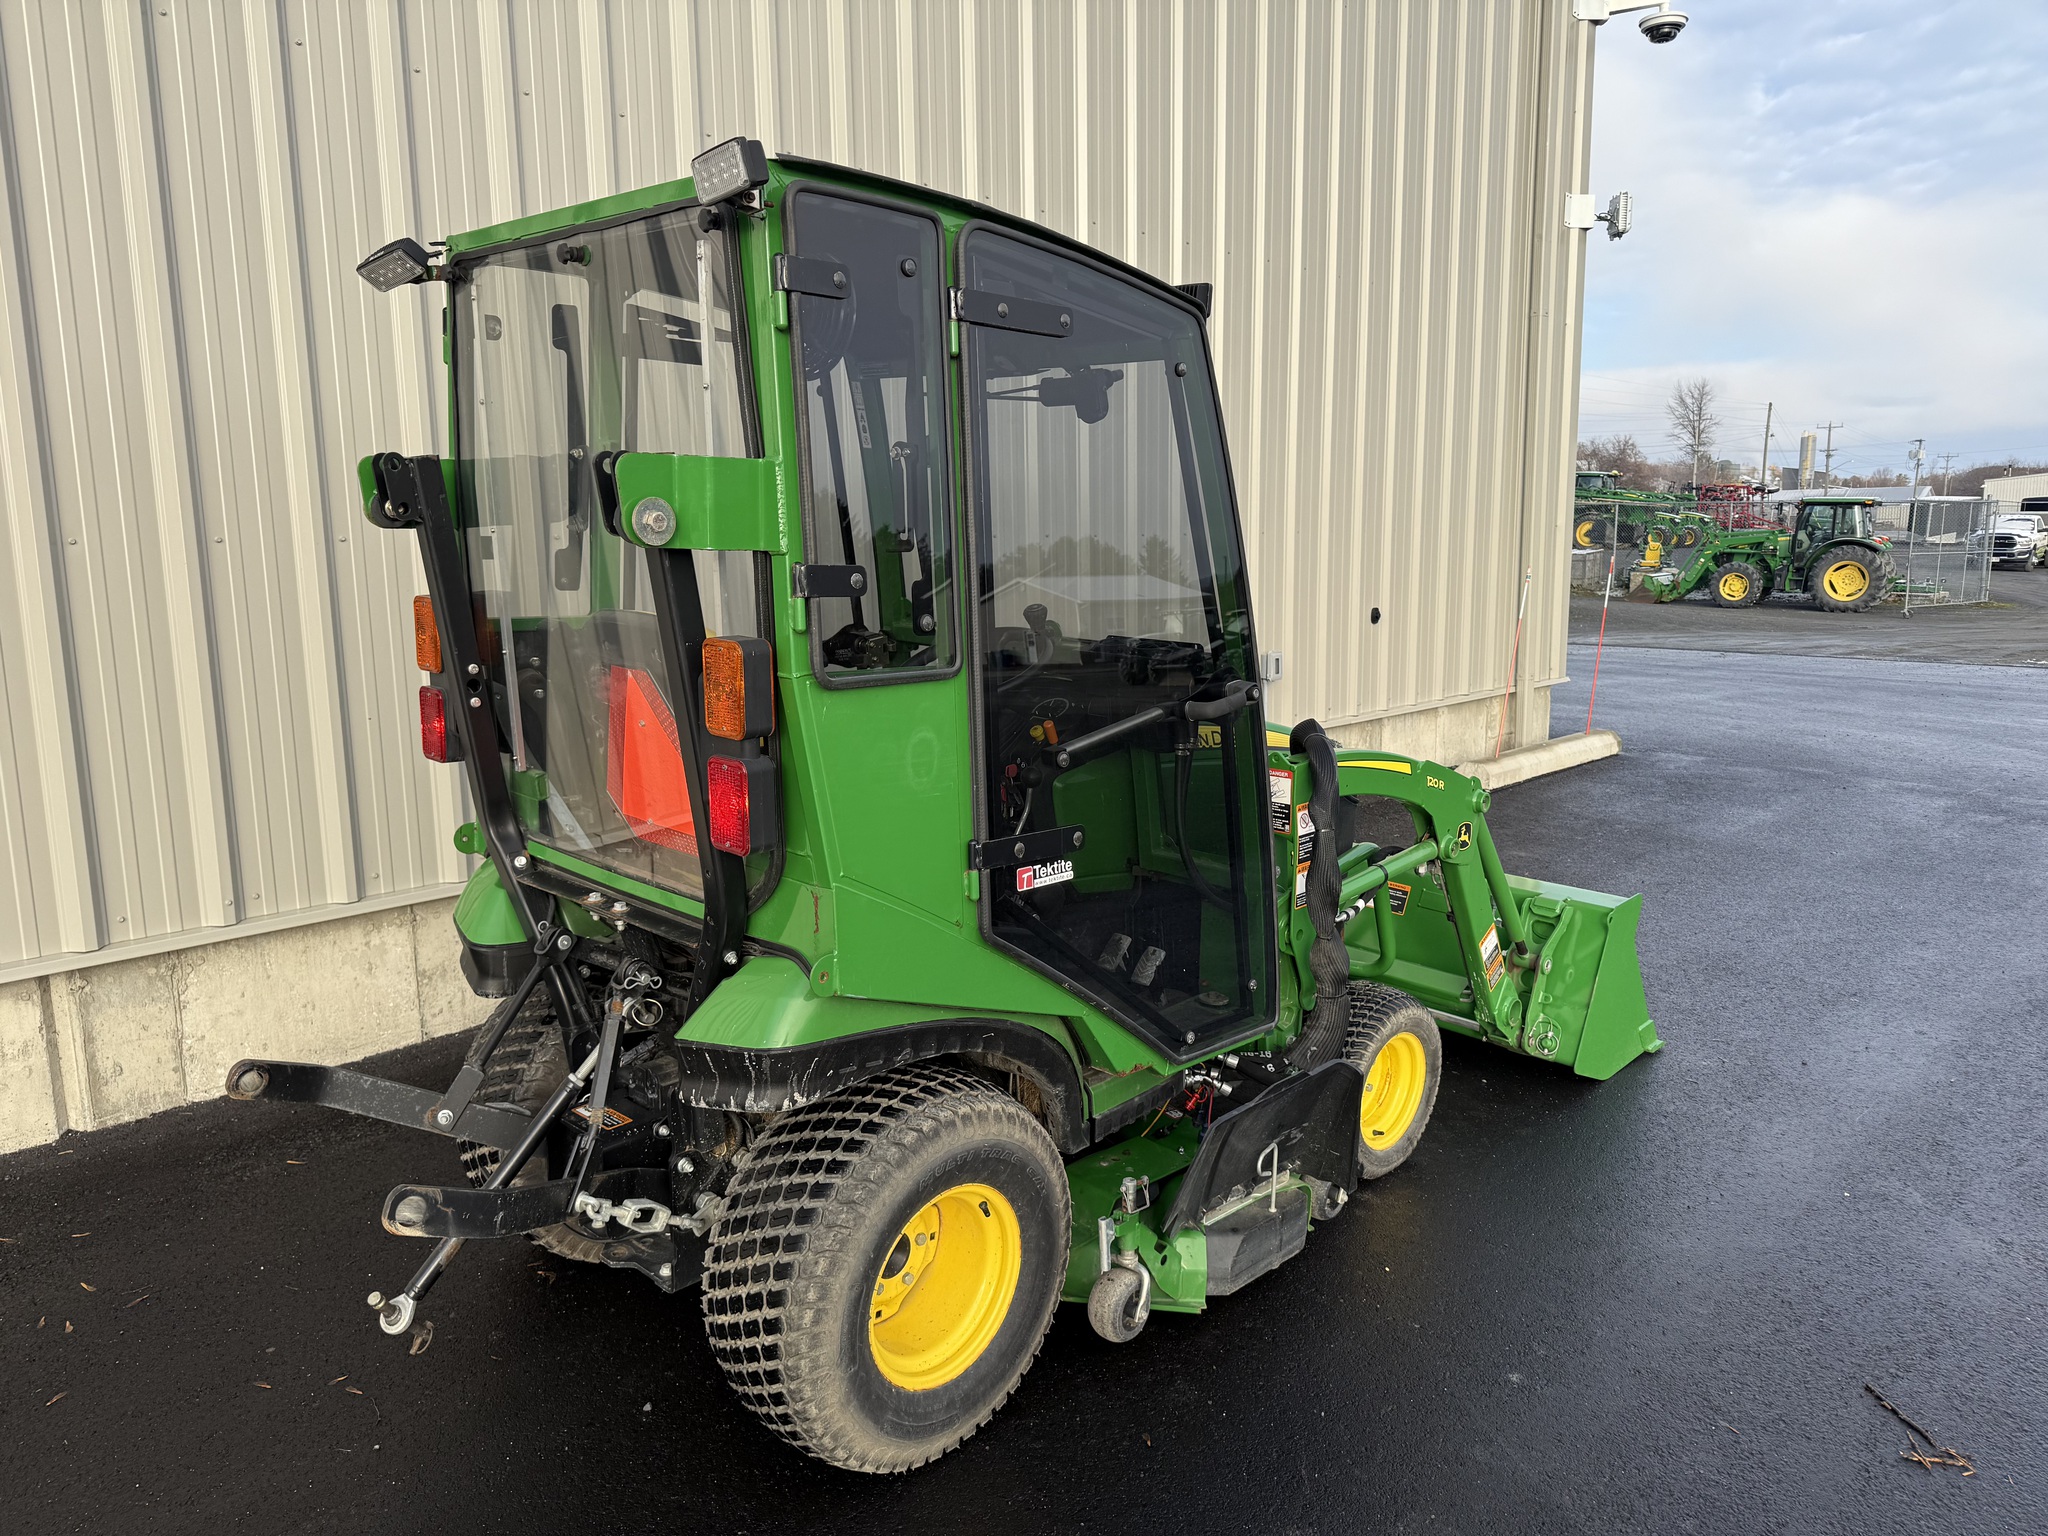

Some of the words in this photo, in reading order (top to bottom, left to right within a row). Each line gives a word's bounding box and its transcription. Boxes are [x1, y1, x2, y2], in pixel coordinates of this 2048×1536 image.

[1033, 859, 1072, 878] Tektite
[1035, 873, 1072, 885] www.tektite.ca
[919, 1150, 975, 1191] MULTI
[980, 1148, 1024, 1165] TRAC
